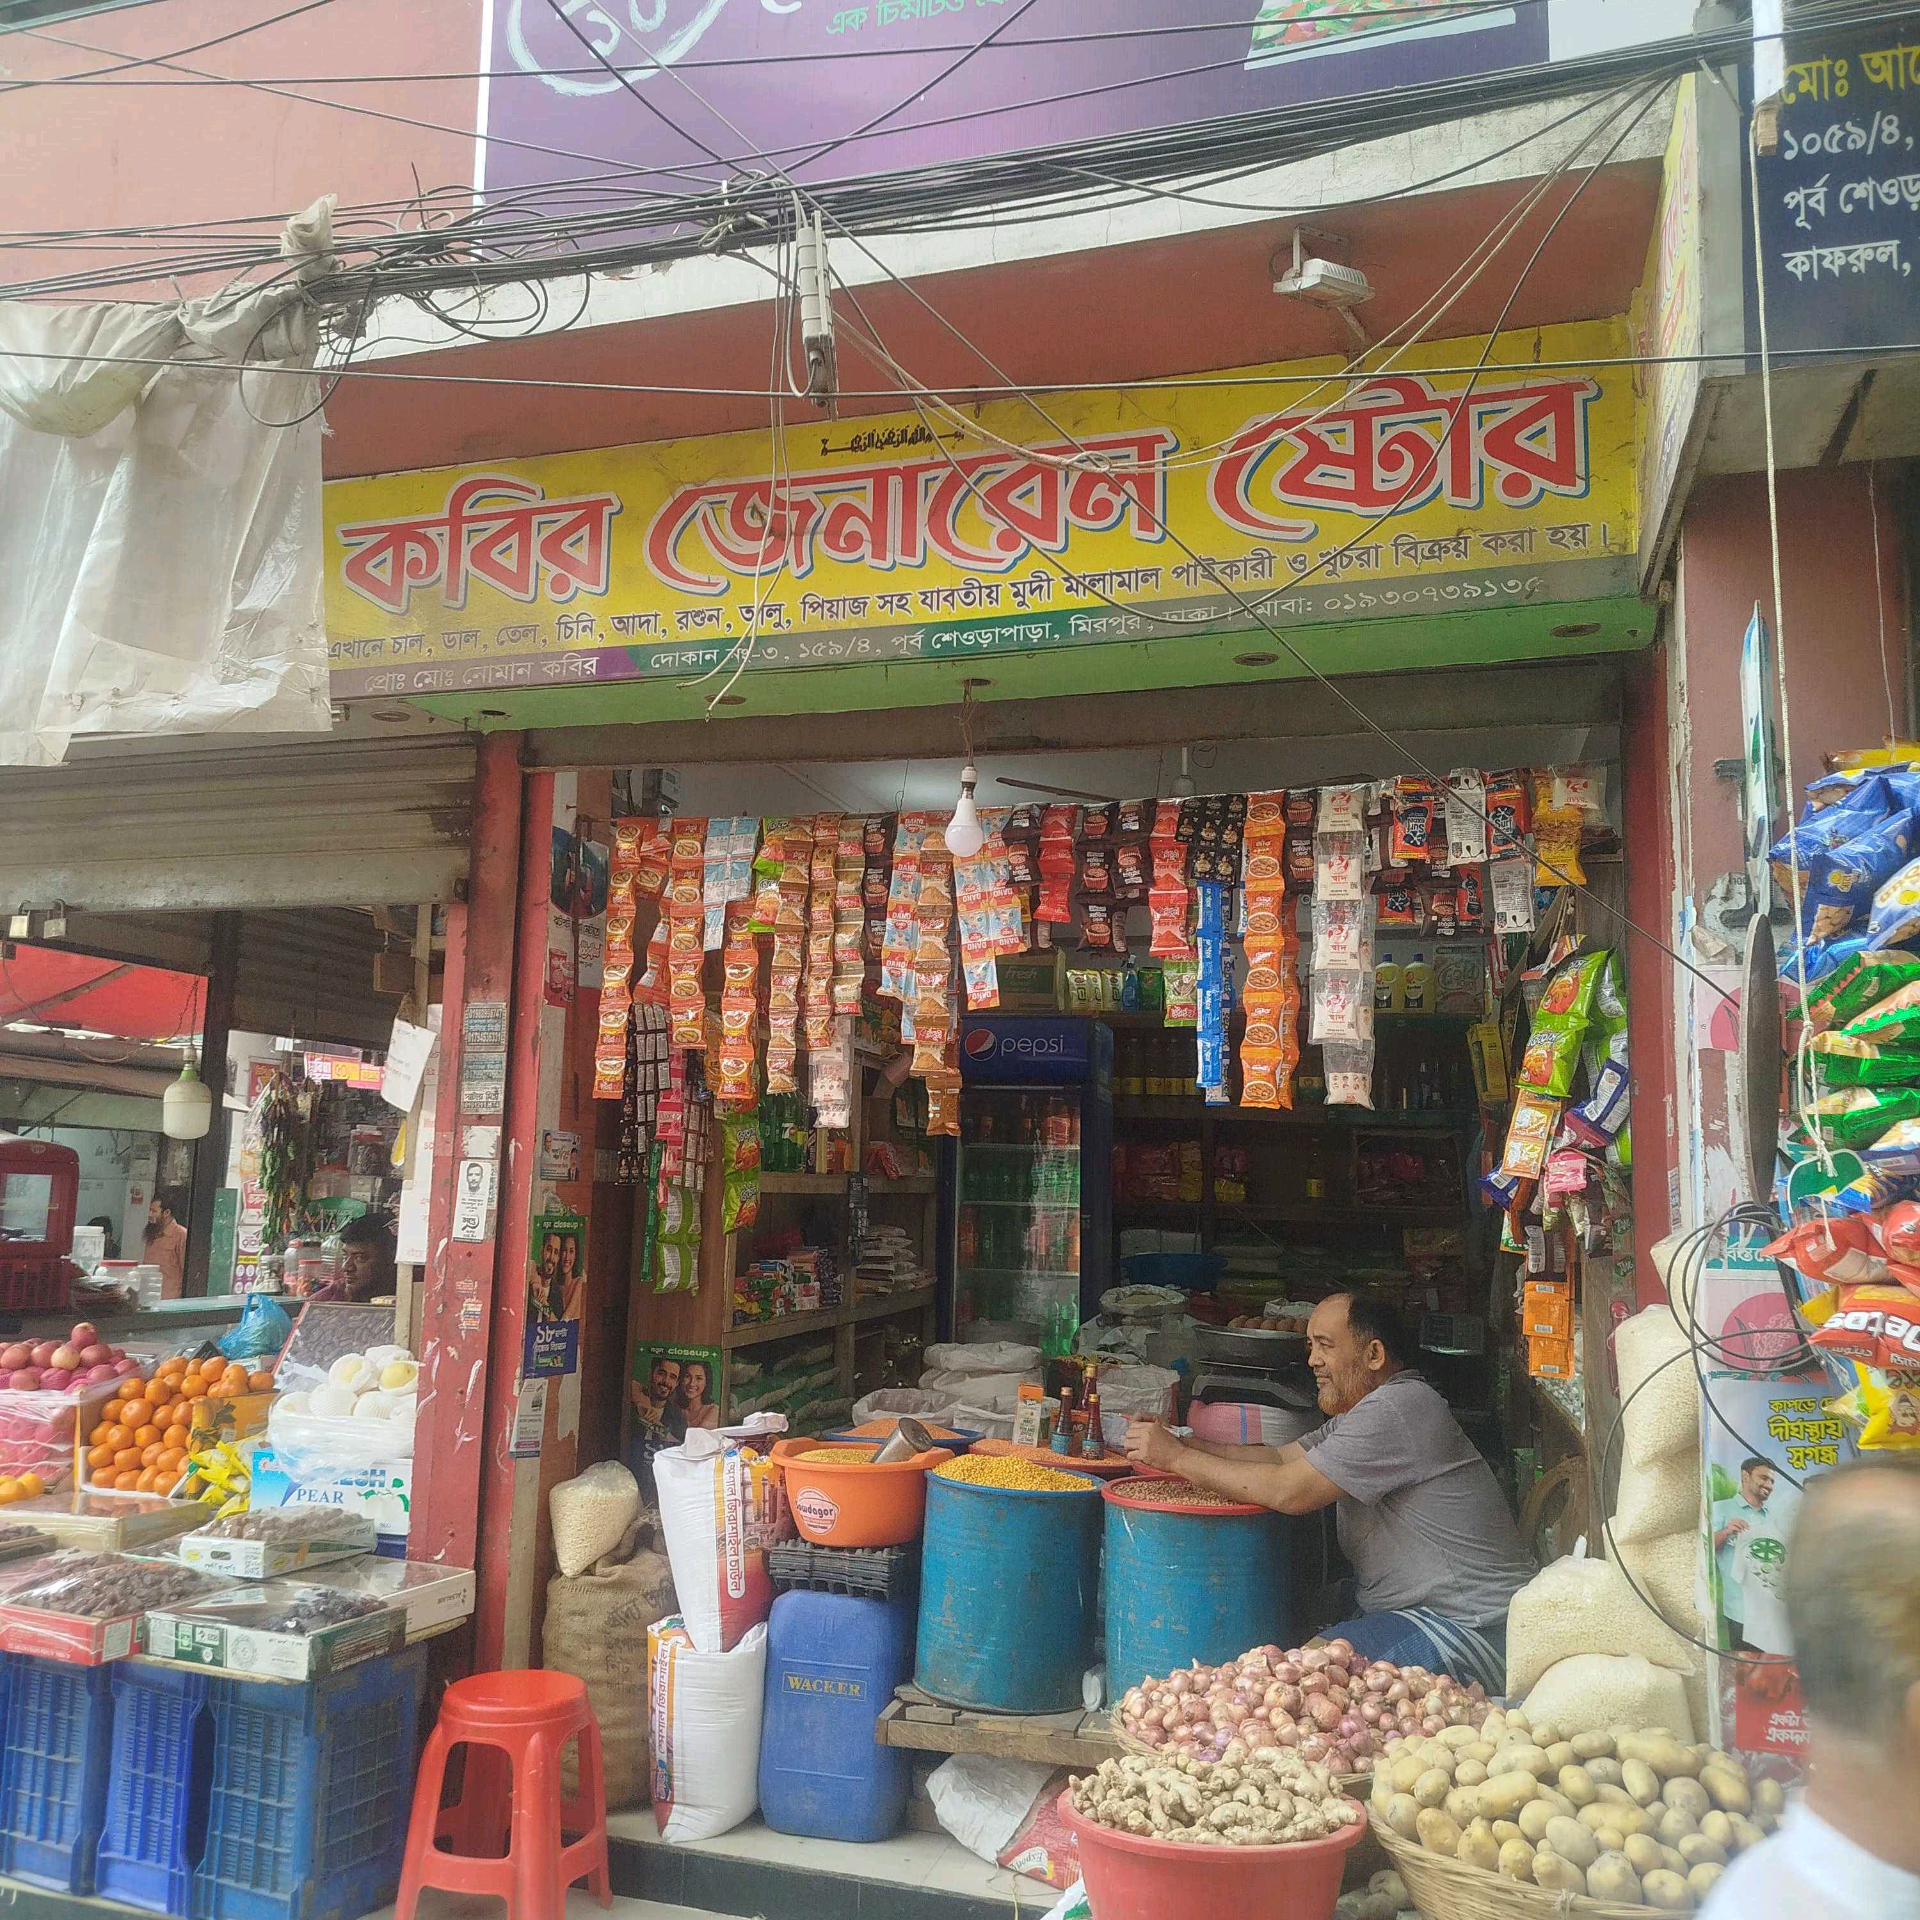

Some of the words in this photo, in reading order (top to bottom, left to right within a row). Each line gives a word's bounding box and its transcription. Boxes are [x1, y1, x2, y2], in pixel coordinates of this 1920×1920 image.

[1783, 111, 1914, 160] ১০৫৯/৪,
[1783, 173, 1832, 230] পূর্ব
[1781, 239, 1912, 282] কাফরুল,
[336, 472, 622, 616] কবির
[643, 427, 1180, 596] জেনারেল
[1206, 374, 1603, 544] ষ্টোর
[328, 637, 384, 661] এখানে
[555, 611, 605, 644] চিনি,
[610, 609, 667, 640] আদা,
[800, 592, 870, 623] পিয়াজ
[877, 590, 912, 617] সহ
[918, 577, 1003, 613] যাবতীয়
[1010, 570, 1055, 608] মুদী
[1062, 566, 1163, 599] মালামাল
[1170, 547, 1278, 588] পাইকারী
[1286, 553, 1308, 573] ও
[1393, 533, 1474, 567] বিক্রয়
[1480, 527, 1538, 556] করা
[650, 648, 717, 670] দোকান
[891, 628, 926, 657] পূর্ব
[412, 665, 454, 690] মোঃ
[463, 659, 532, 686] নোমান
[540, 652, 600, 679] কবির
[1406, 823, 1426, 834] Surf
[1494, 818, 1513, 830] Surf
[897, 863, 917, 872] DANO
[891, 911, 912, 920] DANO
[968, 941, 987, 950] DANO
[885, 959, 906, 968] DANO
[1001, 1034, 1064, 1057] pepsi
[553, 1220, 579, 1230] closeup
[668, 1347, 710, 1358] closeup
[1769, 1397, 1817, 1414] কাপড়ে
[1787, 1444, 1839, 1470] সুগন্ধ
[296, 1488, 344, 1504] PEAR
[727, 1499, 741, 1558] জিরাশাইল
[729, 1559, 743, 1592] চাউল
[787, 1675, 861, 1696] WACKER
